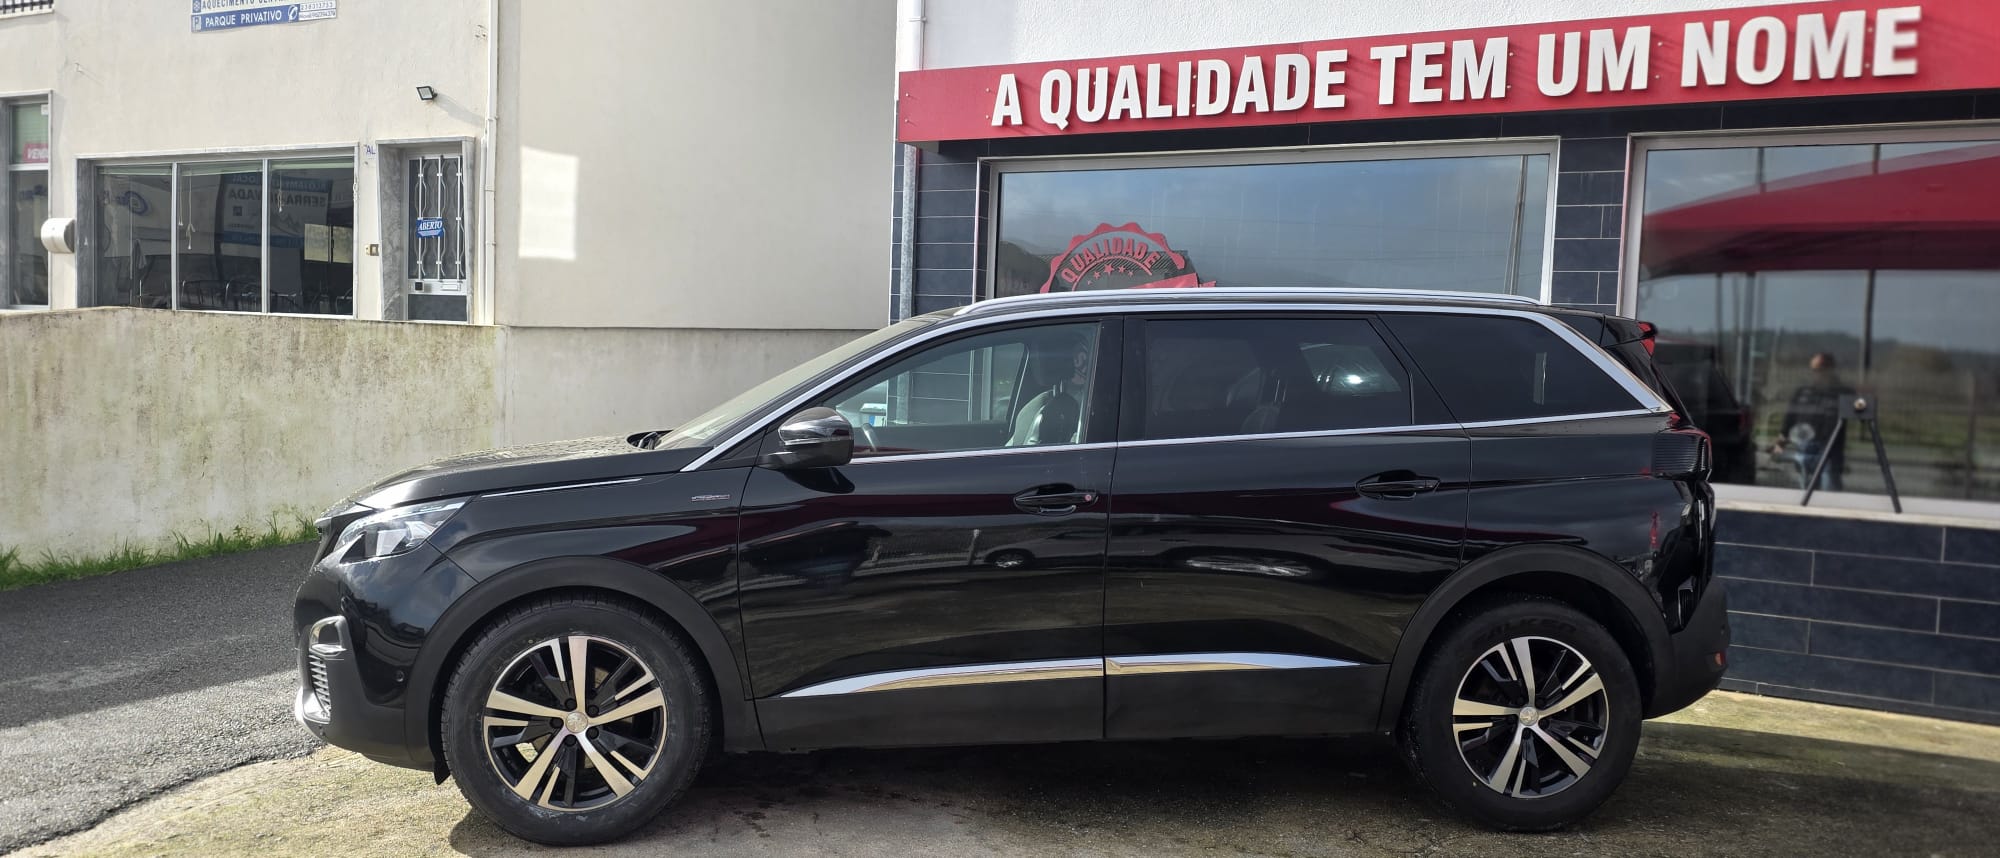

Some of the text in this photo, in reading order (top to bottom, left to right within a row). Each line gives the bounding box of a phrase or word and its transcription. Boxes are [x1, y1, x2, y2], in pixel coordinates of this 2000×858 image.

[205, 14, 236, 27] PARQUE
[241, 10, 282, 24] PRIVATIVO
[991, 6, 1922, 130] A QUALIDADE TEM UM NOME
[418, 220, 443, 231] ABERTO
[1060, 237, 1161, 283] QUALIDADE
